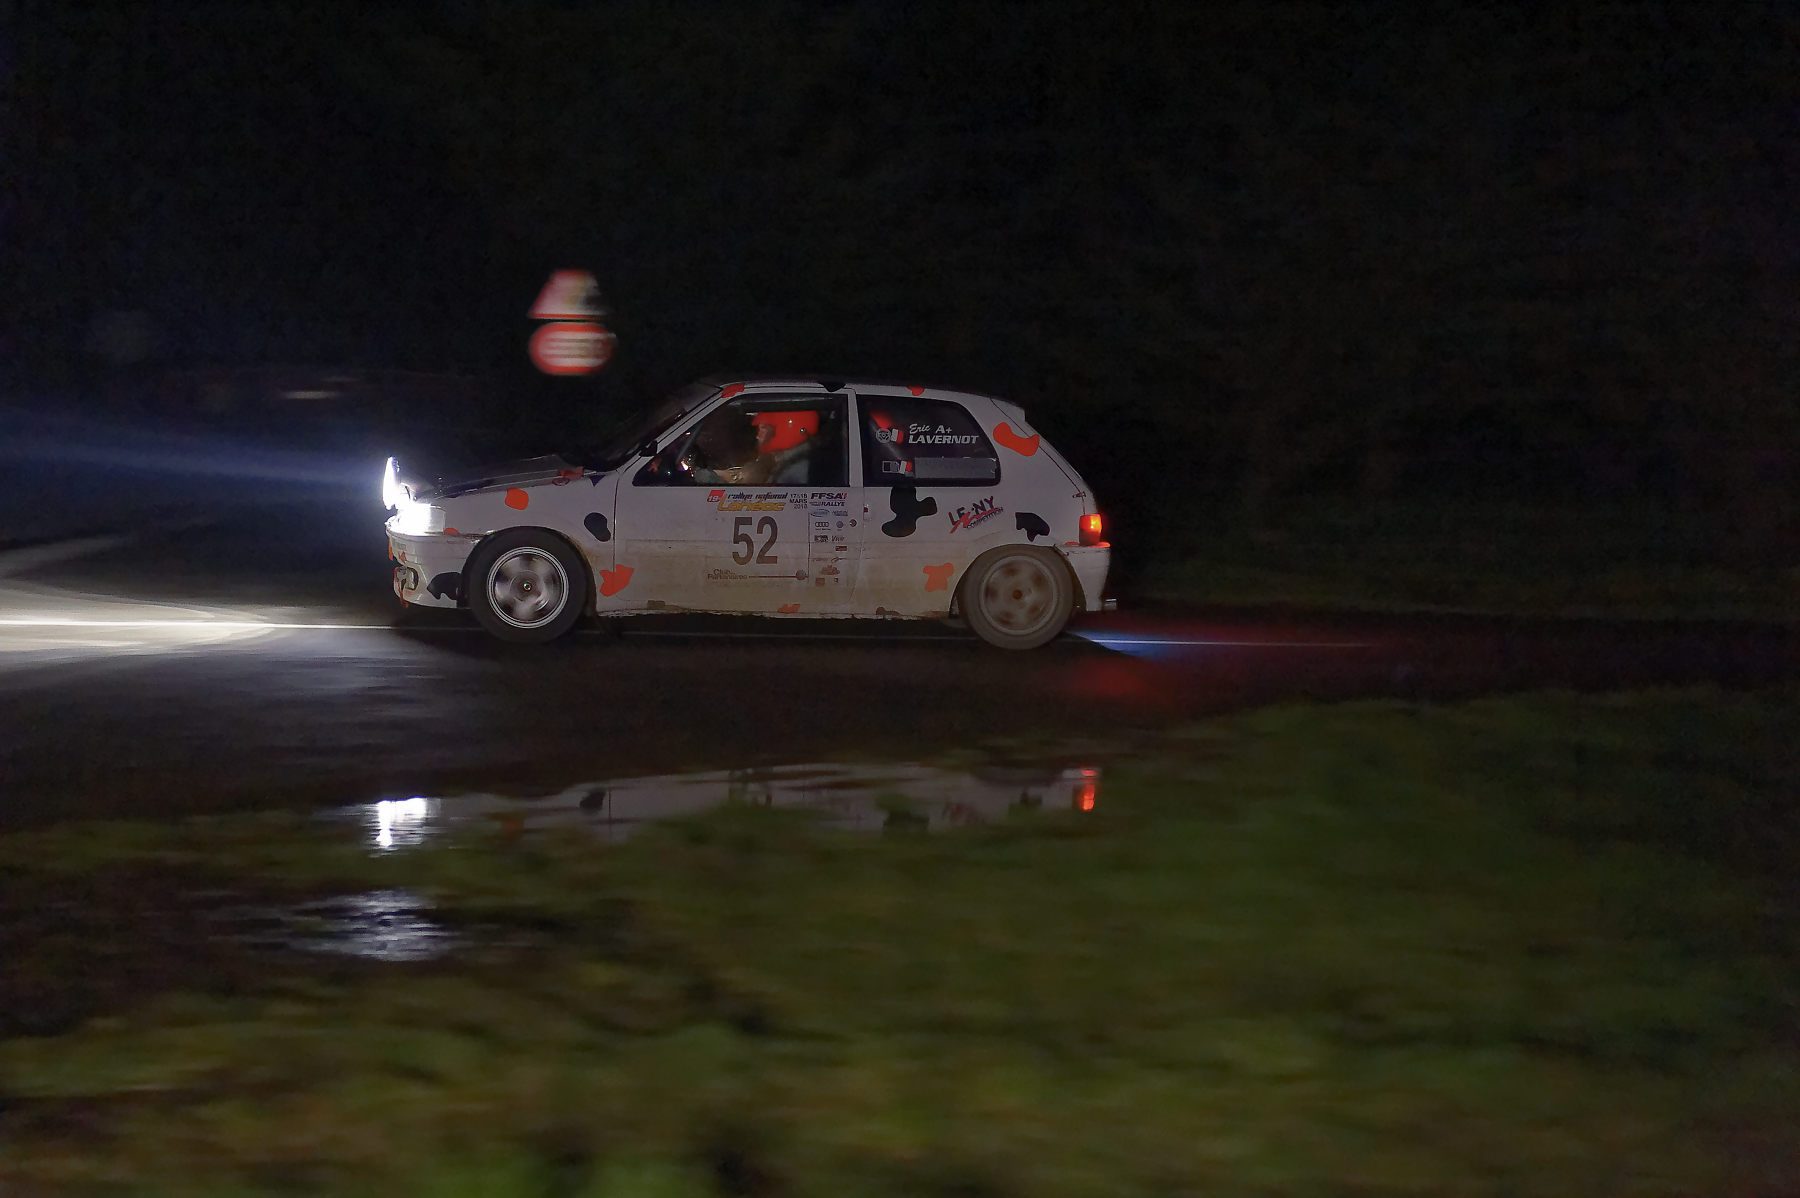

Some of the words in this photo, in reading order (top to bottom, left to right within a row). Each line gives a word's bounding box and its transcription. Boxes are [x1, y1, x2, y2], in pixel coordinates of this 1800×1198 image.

[909, 424, 931, 434] Eric
[908, 435, 979, 444] LAVERNOT
[810, 492, 845, 500] FFSA
[731, 515, 778, 566] 52
